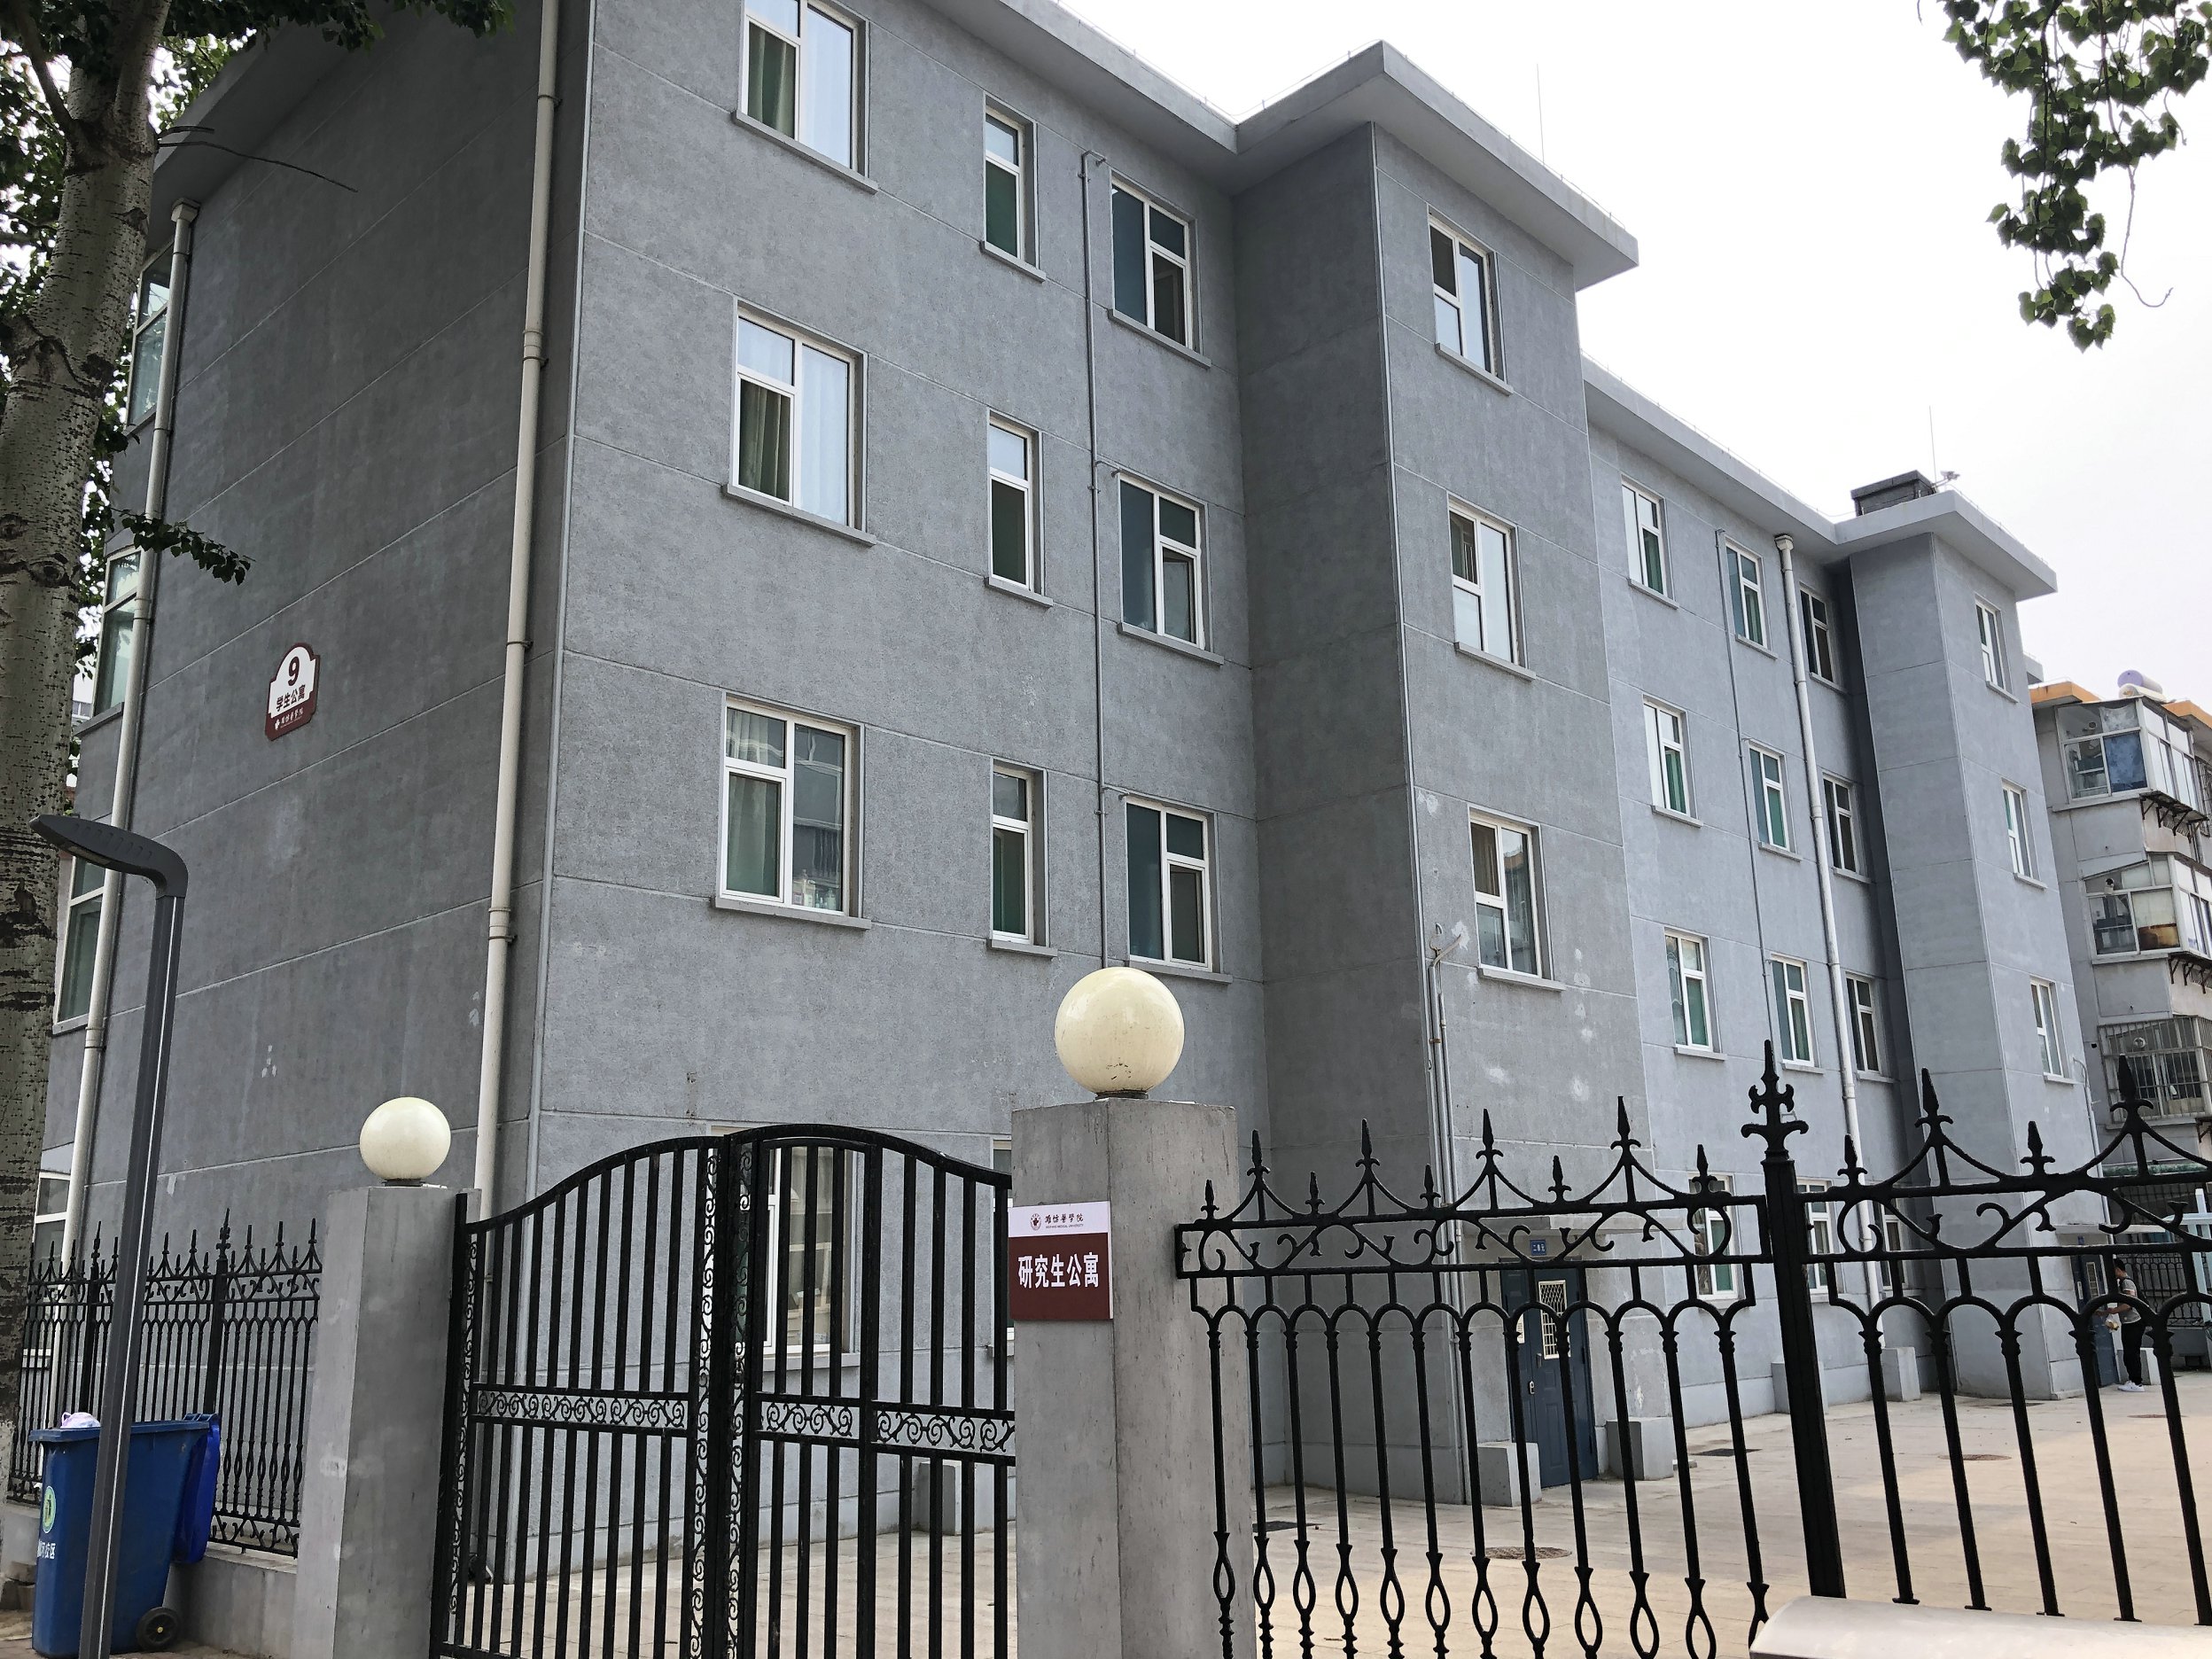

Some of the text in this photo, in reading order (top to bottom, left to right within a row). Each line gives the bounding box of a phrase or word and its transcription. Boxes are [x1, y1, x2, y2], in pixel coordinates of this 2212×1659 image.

[288, 657, 300, 686] 9
[276, 685, 306, 712] 学生公寓
[1018, 1252, 1098, 1289] 研究生公寓
